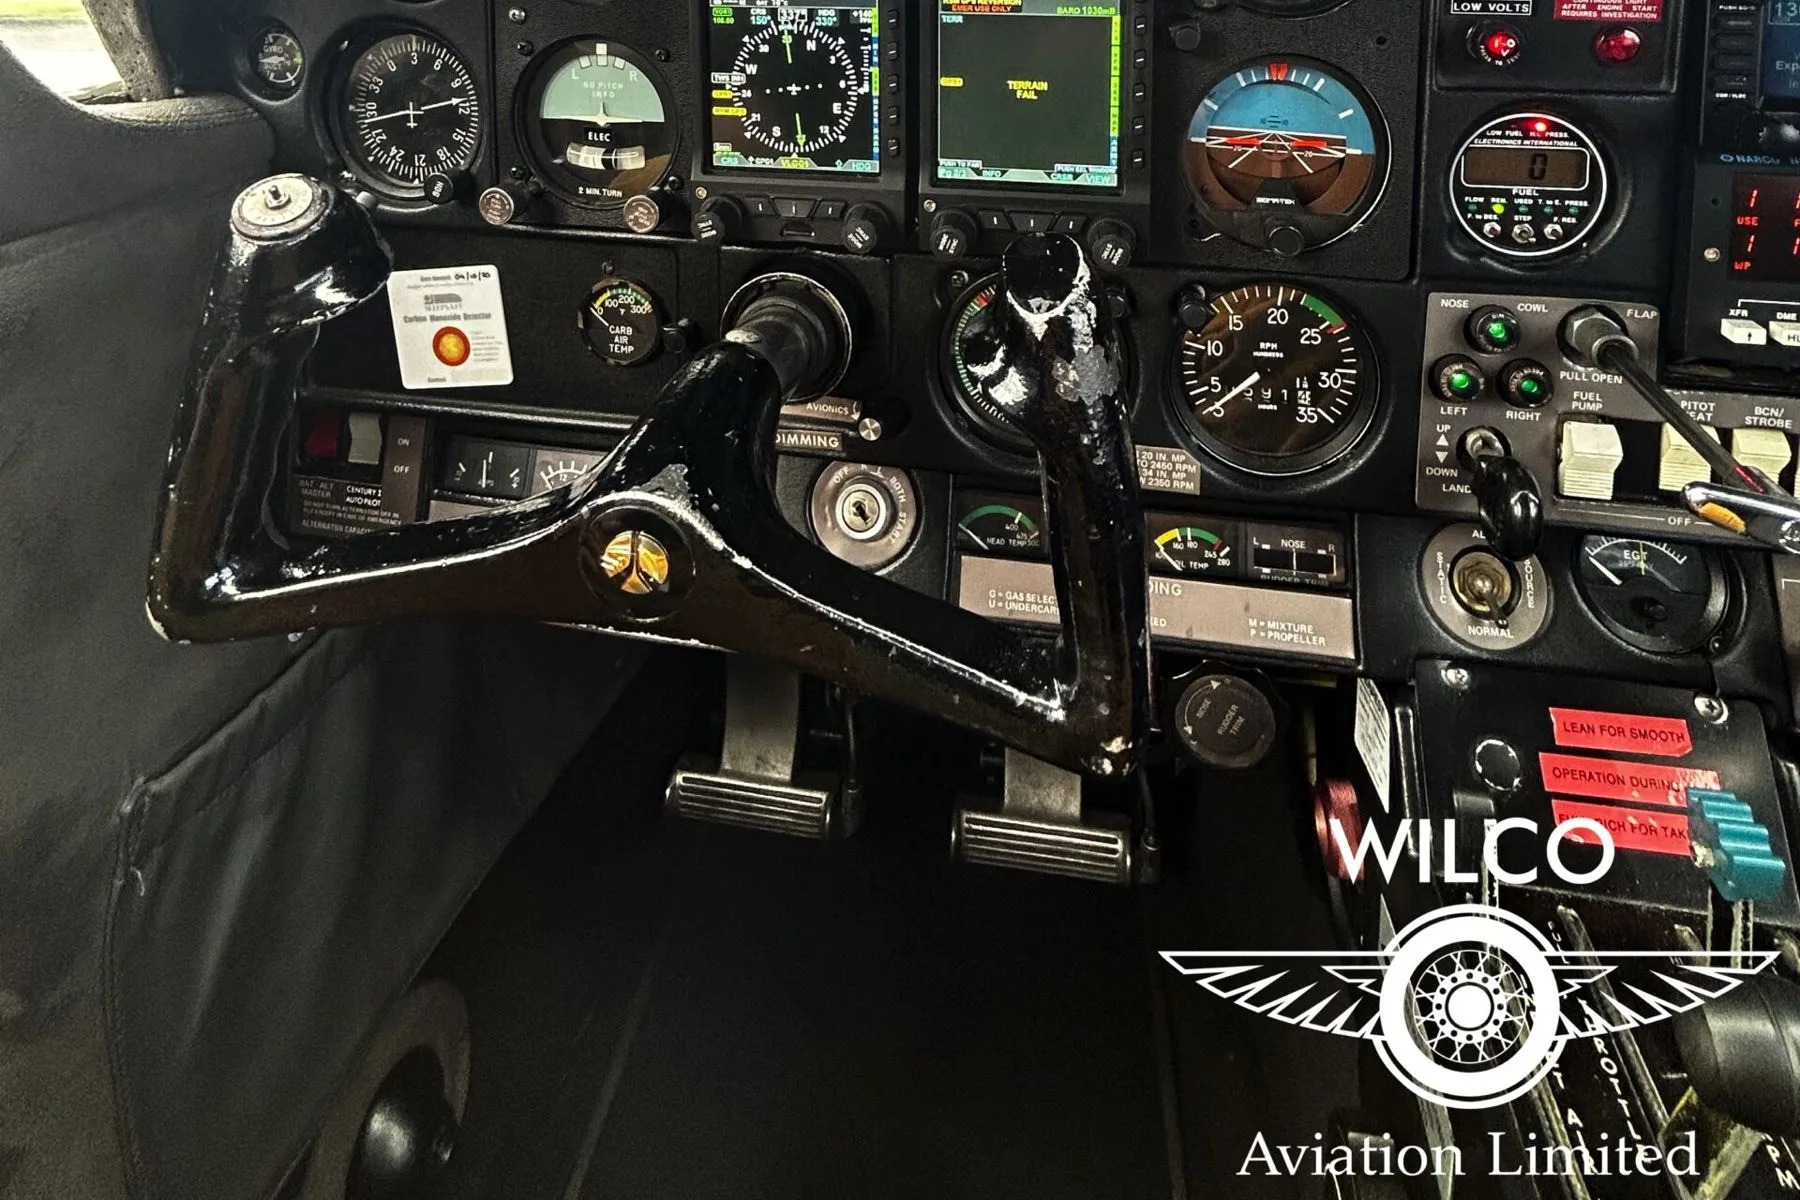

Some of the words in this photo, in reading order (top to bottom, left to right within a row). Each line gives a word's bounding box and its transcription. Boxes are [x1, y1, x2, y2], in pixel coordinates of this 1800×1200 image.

[1453, 2, 1481, 12] LOW
[1488, 3, 1529, 13] VOLTS
[1597, 4, 1623, 12] ENGINE
[1632, 4, 1657, 12] START
[1561, 10, 1598, 18] REQUIRES
[1601, 11, 1657, 19] INVESTIGATION
[1007, 80, 1048, 90] TERRAIN
[1016, 90, 1038, 99] FAIL
[588, 131, 611, 142] ELEC
[1086, 175, 1111, 184] VIEW
[585, 188, 601, 196] MIN.
[602, 188, 622, 197] TURN
[1737, 216, 1759, 226] USE
[605, 299, 619, 308] 100
[619, 295, 635, 304] 200
[1441, 300, 1469, 308] NOSE
[630, 305, 647, 314] 300
[1517, 303, 1549, 312] COWL
[1729, 308, 1748, 317] XFR
[1267, 309, 1288, 324] 20
[1627, 309, 1658, 319] FLAP
[1776, 312, 1797, 320] DME
[1229, 315, 1243, 330] 15
[609, 325, 633, 335] CARB
[614, 336, 628, 344] AIR
[1300, 328, 1321, 345] 25
[609, 344, 634, 354] TEMP
[1207, 341, 1223, 356] 10
[1260, 342, 1278, 350] RPM
[1318, 372, 1341, 389] 30
[1560, 371, 1587, 381] PULL
[1591, 374, 1622, 384] OPEN
[1573, 391, 1603, 401] FUEL
[806, 403, 849, 415] AVIONICS
[1572, 401, 1603, 411] PUMP
[1681, 401, 1715, 411] PITOT
[1296, 407, 1317, 423] 35
[1440, 407, 1468, 416] LEFT
[1506, 411, 1541, 422] RIGHT
[1754, 406, 1784, 417] BCN/
[1745, 416, 1793, 428] STROBE
[1437, 424, 1451, 433] UP
[1142, 452, 1153, 460] 20
[1156, 453, 1169, 461] IN.
[1172, 454, 1185, 462] MP
[393, 465, 410, 474] OFF
[1150, 461, 1172, 470] 2450
[1176, 463, 1196, 473] RPM
[1426, 467, 1458, 477] DOWN
[833, 466, 850, 484] OFF
[1157, 470, 1169, 478] IN.
[1172, 472, 1186, 480] MP
[1148, 478, 1171, 487] 2350
[1173, 481, 1194, 490] RPM
[890, 476, 906, 503] BOTH
[1667, 516, 1692, 527] OFF
[890, 512, 907, 542] START
[1281, 539, 1306, 549] NOSE
[1624, 549, 1648, 561] EGT
[1436, 552, 1446, 604] STATIC
[1249, 619, 1257, 627] M
[1268, 621, 1313, 634] MIXTURE
[1468, 625, 1514, 639] NORMAL
[1268, 631, 1326, 646] PROPELLER
[1217, 704, 1239, 736] RUDDER
[1230, 715, 1245, 735] TRIM
[1563, 721, 1595, 735] LEAN
[1600, 724, 1625, 738] FOR
[1631, 726, 1685, 742] SMOOTH
[1552, 766, 1625, 787] OPERATION
[1630, 776, 1680, 793] DURING
